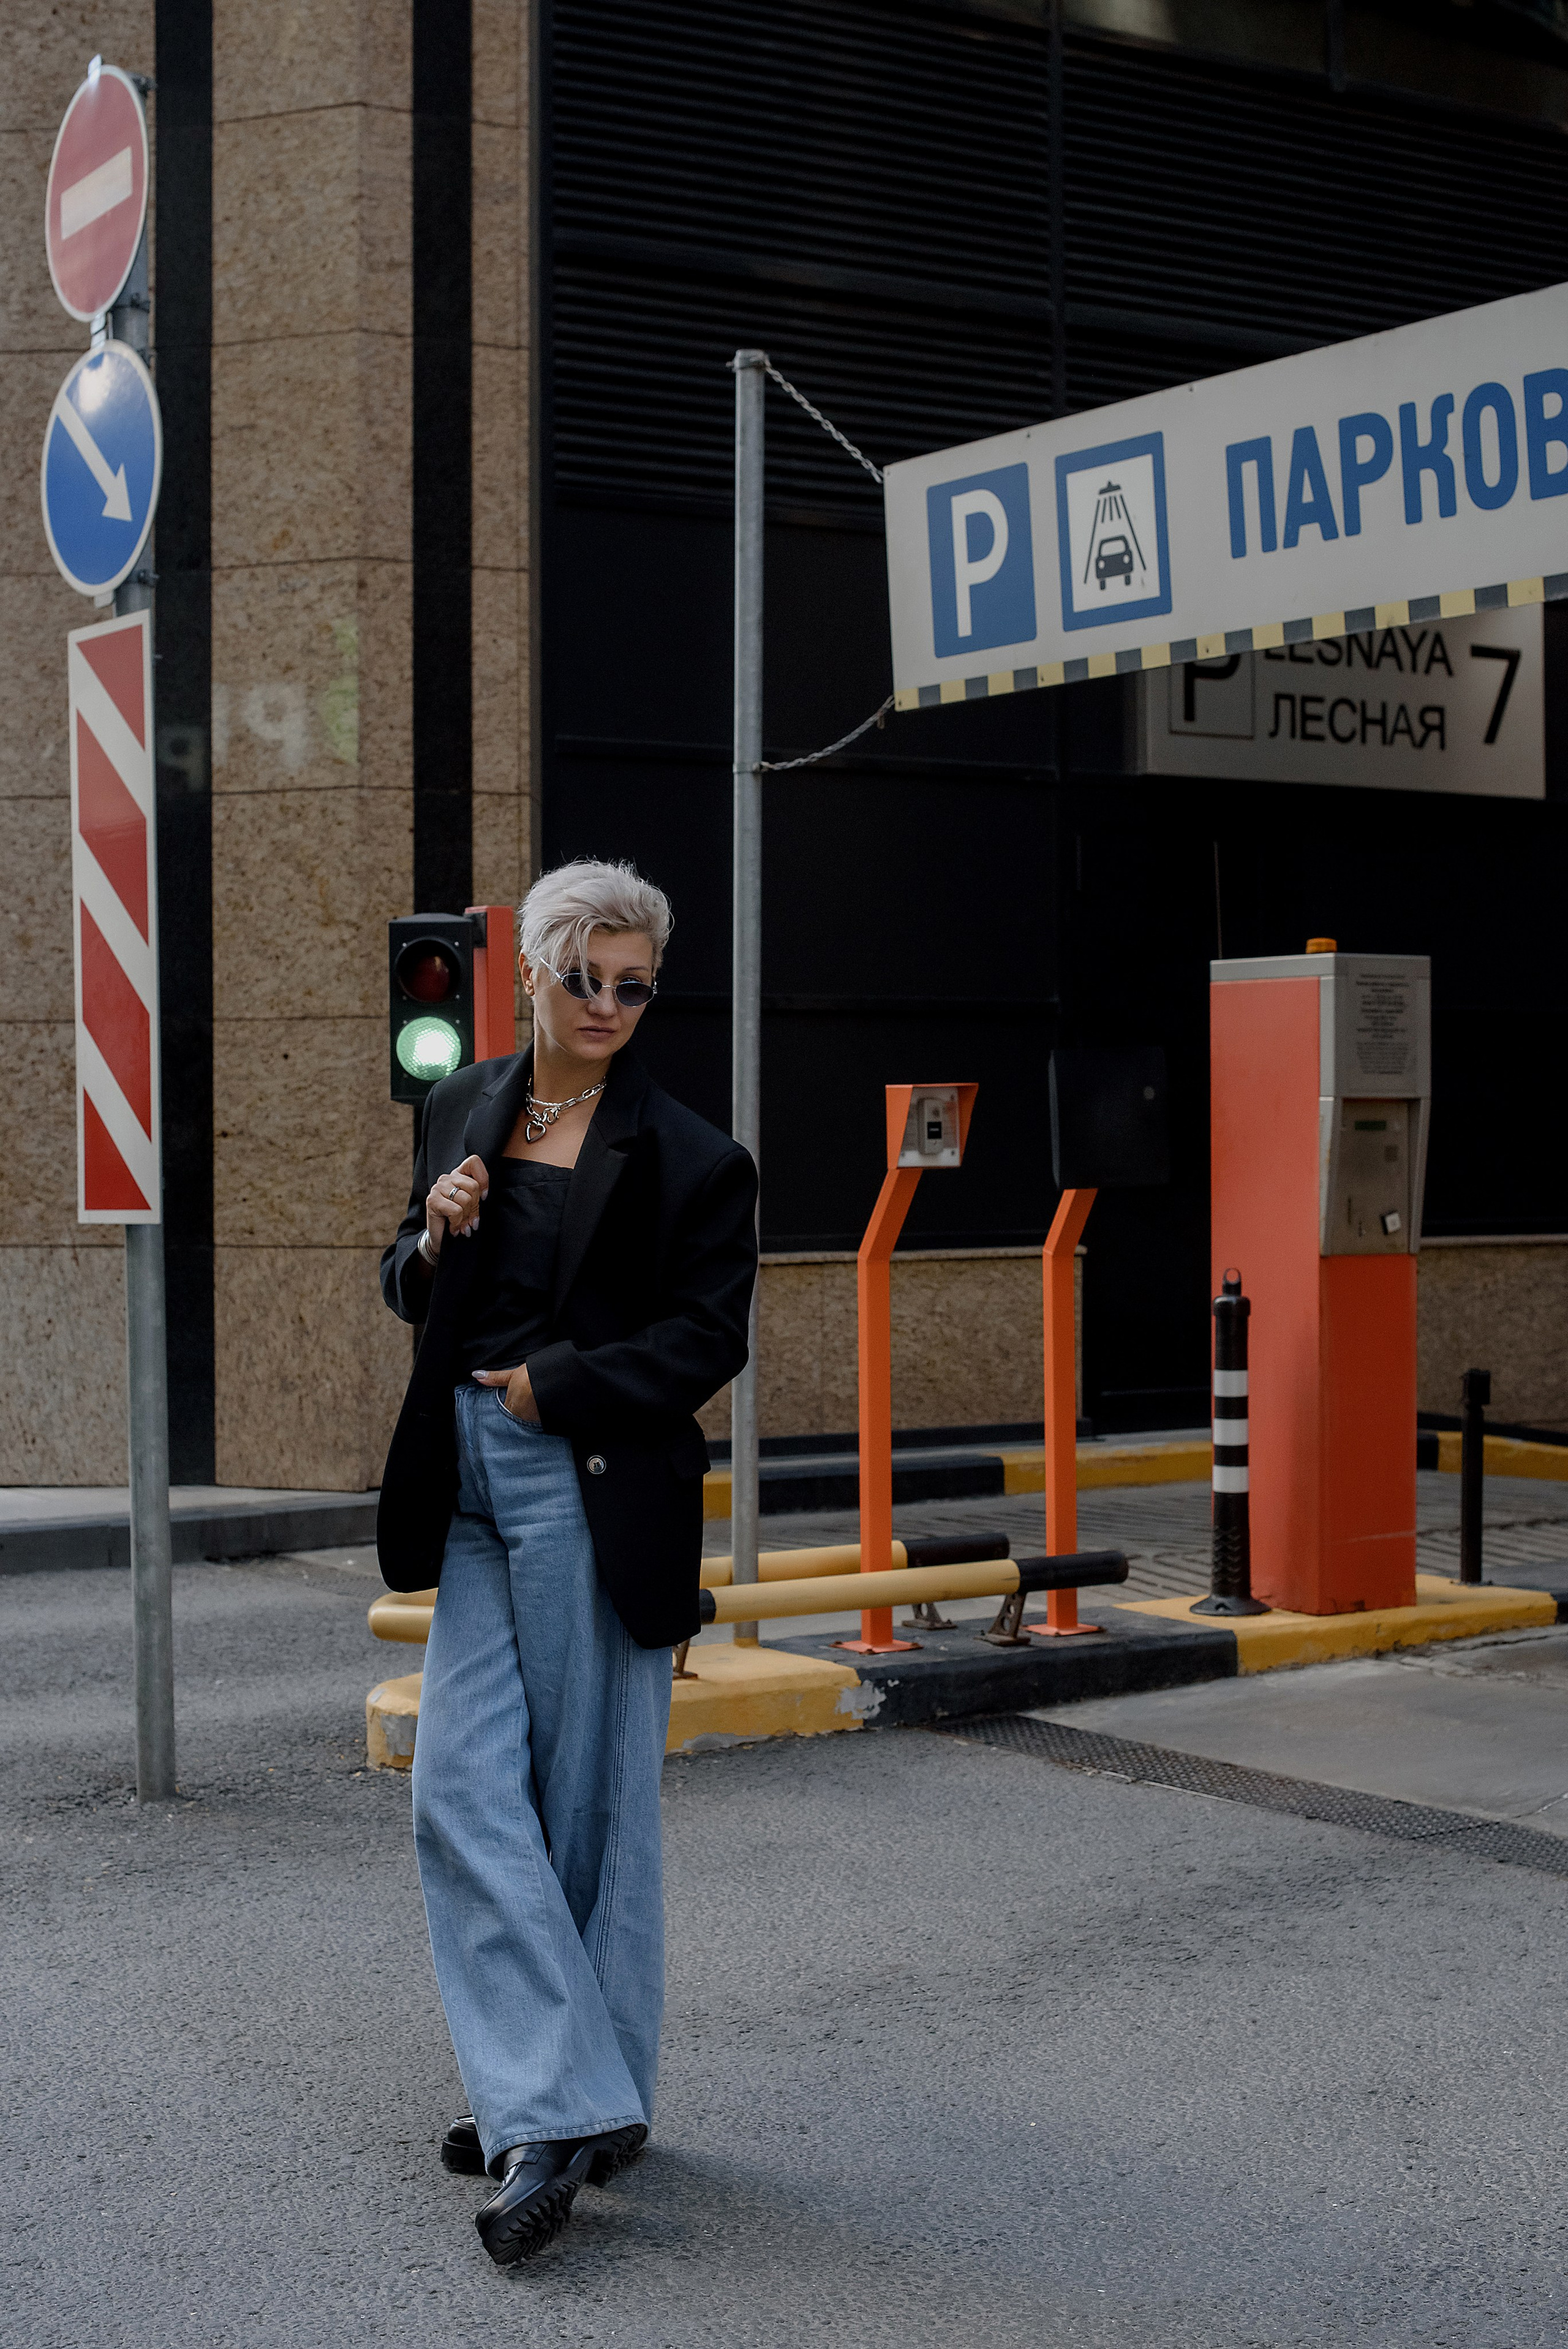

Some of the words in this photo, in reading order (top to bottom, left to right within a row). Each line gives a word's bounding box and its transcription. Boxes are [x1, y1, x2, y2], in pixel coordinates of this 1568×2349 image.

[1226, 368, 1568, 559] ПАРКОВ
[951, 489, 1009, 638] P
[1265, 628, 1453, 676] ESNAYA
[1470, 645, 1521, 744] 7
[1268, 693, 1446, 751] ЛЕСНАЯ
